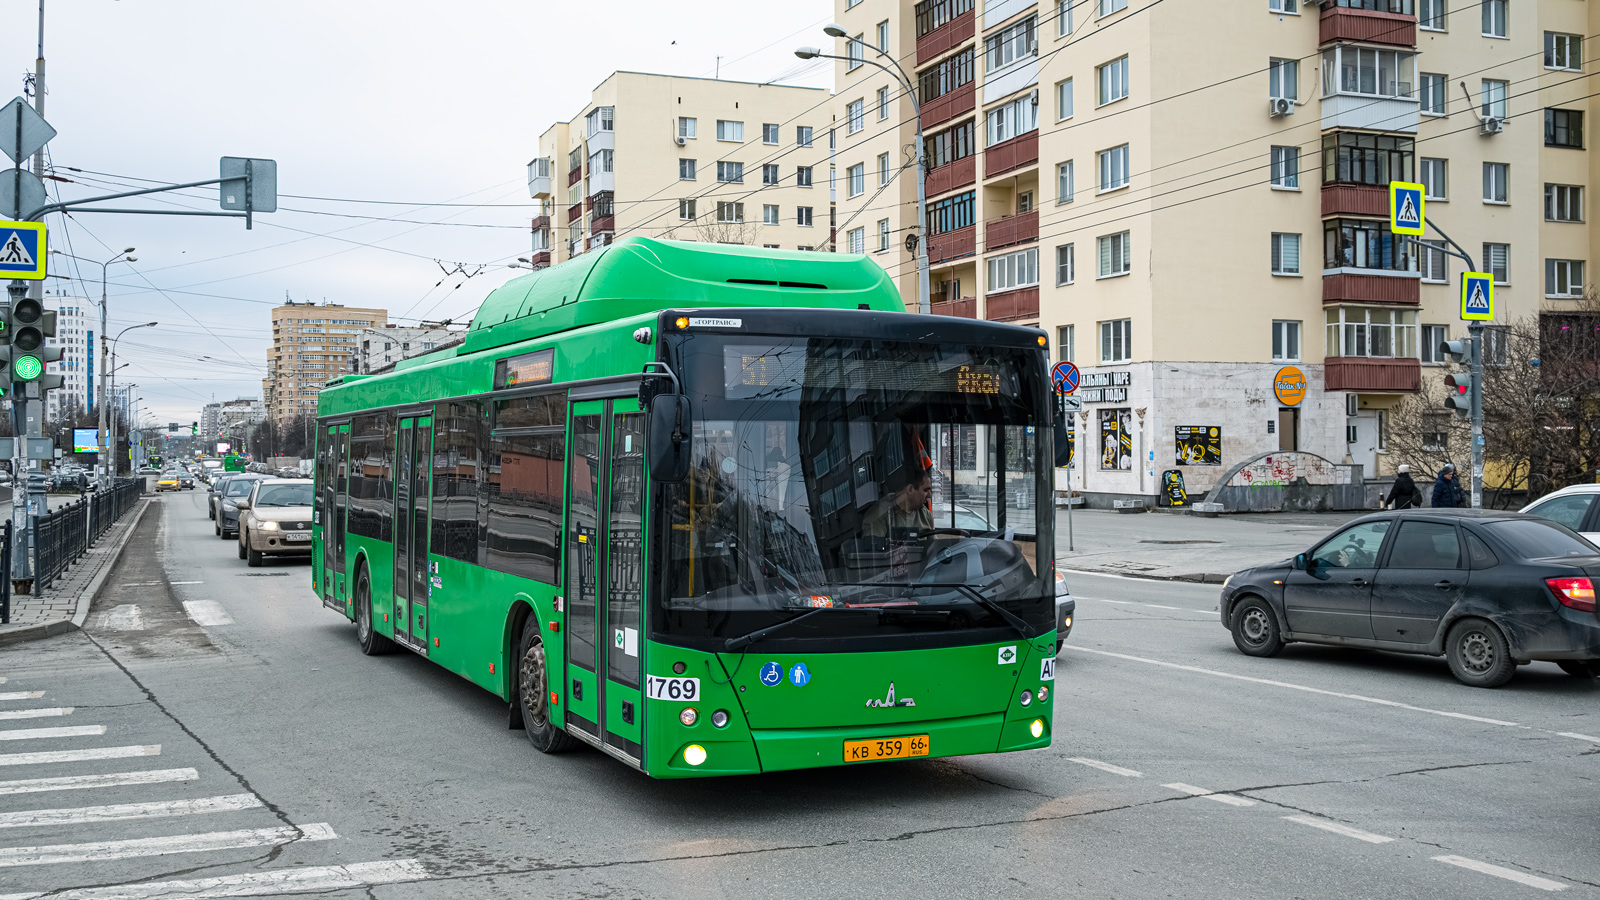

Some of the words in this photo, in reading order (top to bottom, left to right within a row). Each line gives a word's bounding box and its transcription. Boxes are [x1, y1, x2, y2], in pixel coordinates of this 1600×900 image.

[1113, 372, 1129, 385] VAPE
[1276, 381, 1295, 390] Табак
[1105, 388, 1126, 403] ПОДЫ
[647, 677, 696, 699] 1769
[852, 746, 869, 759] КВ
[876, 740, 903, 757] 359
[910, 738, 925, 750] 66
